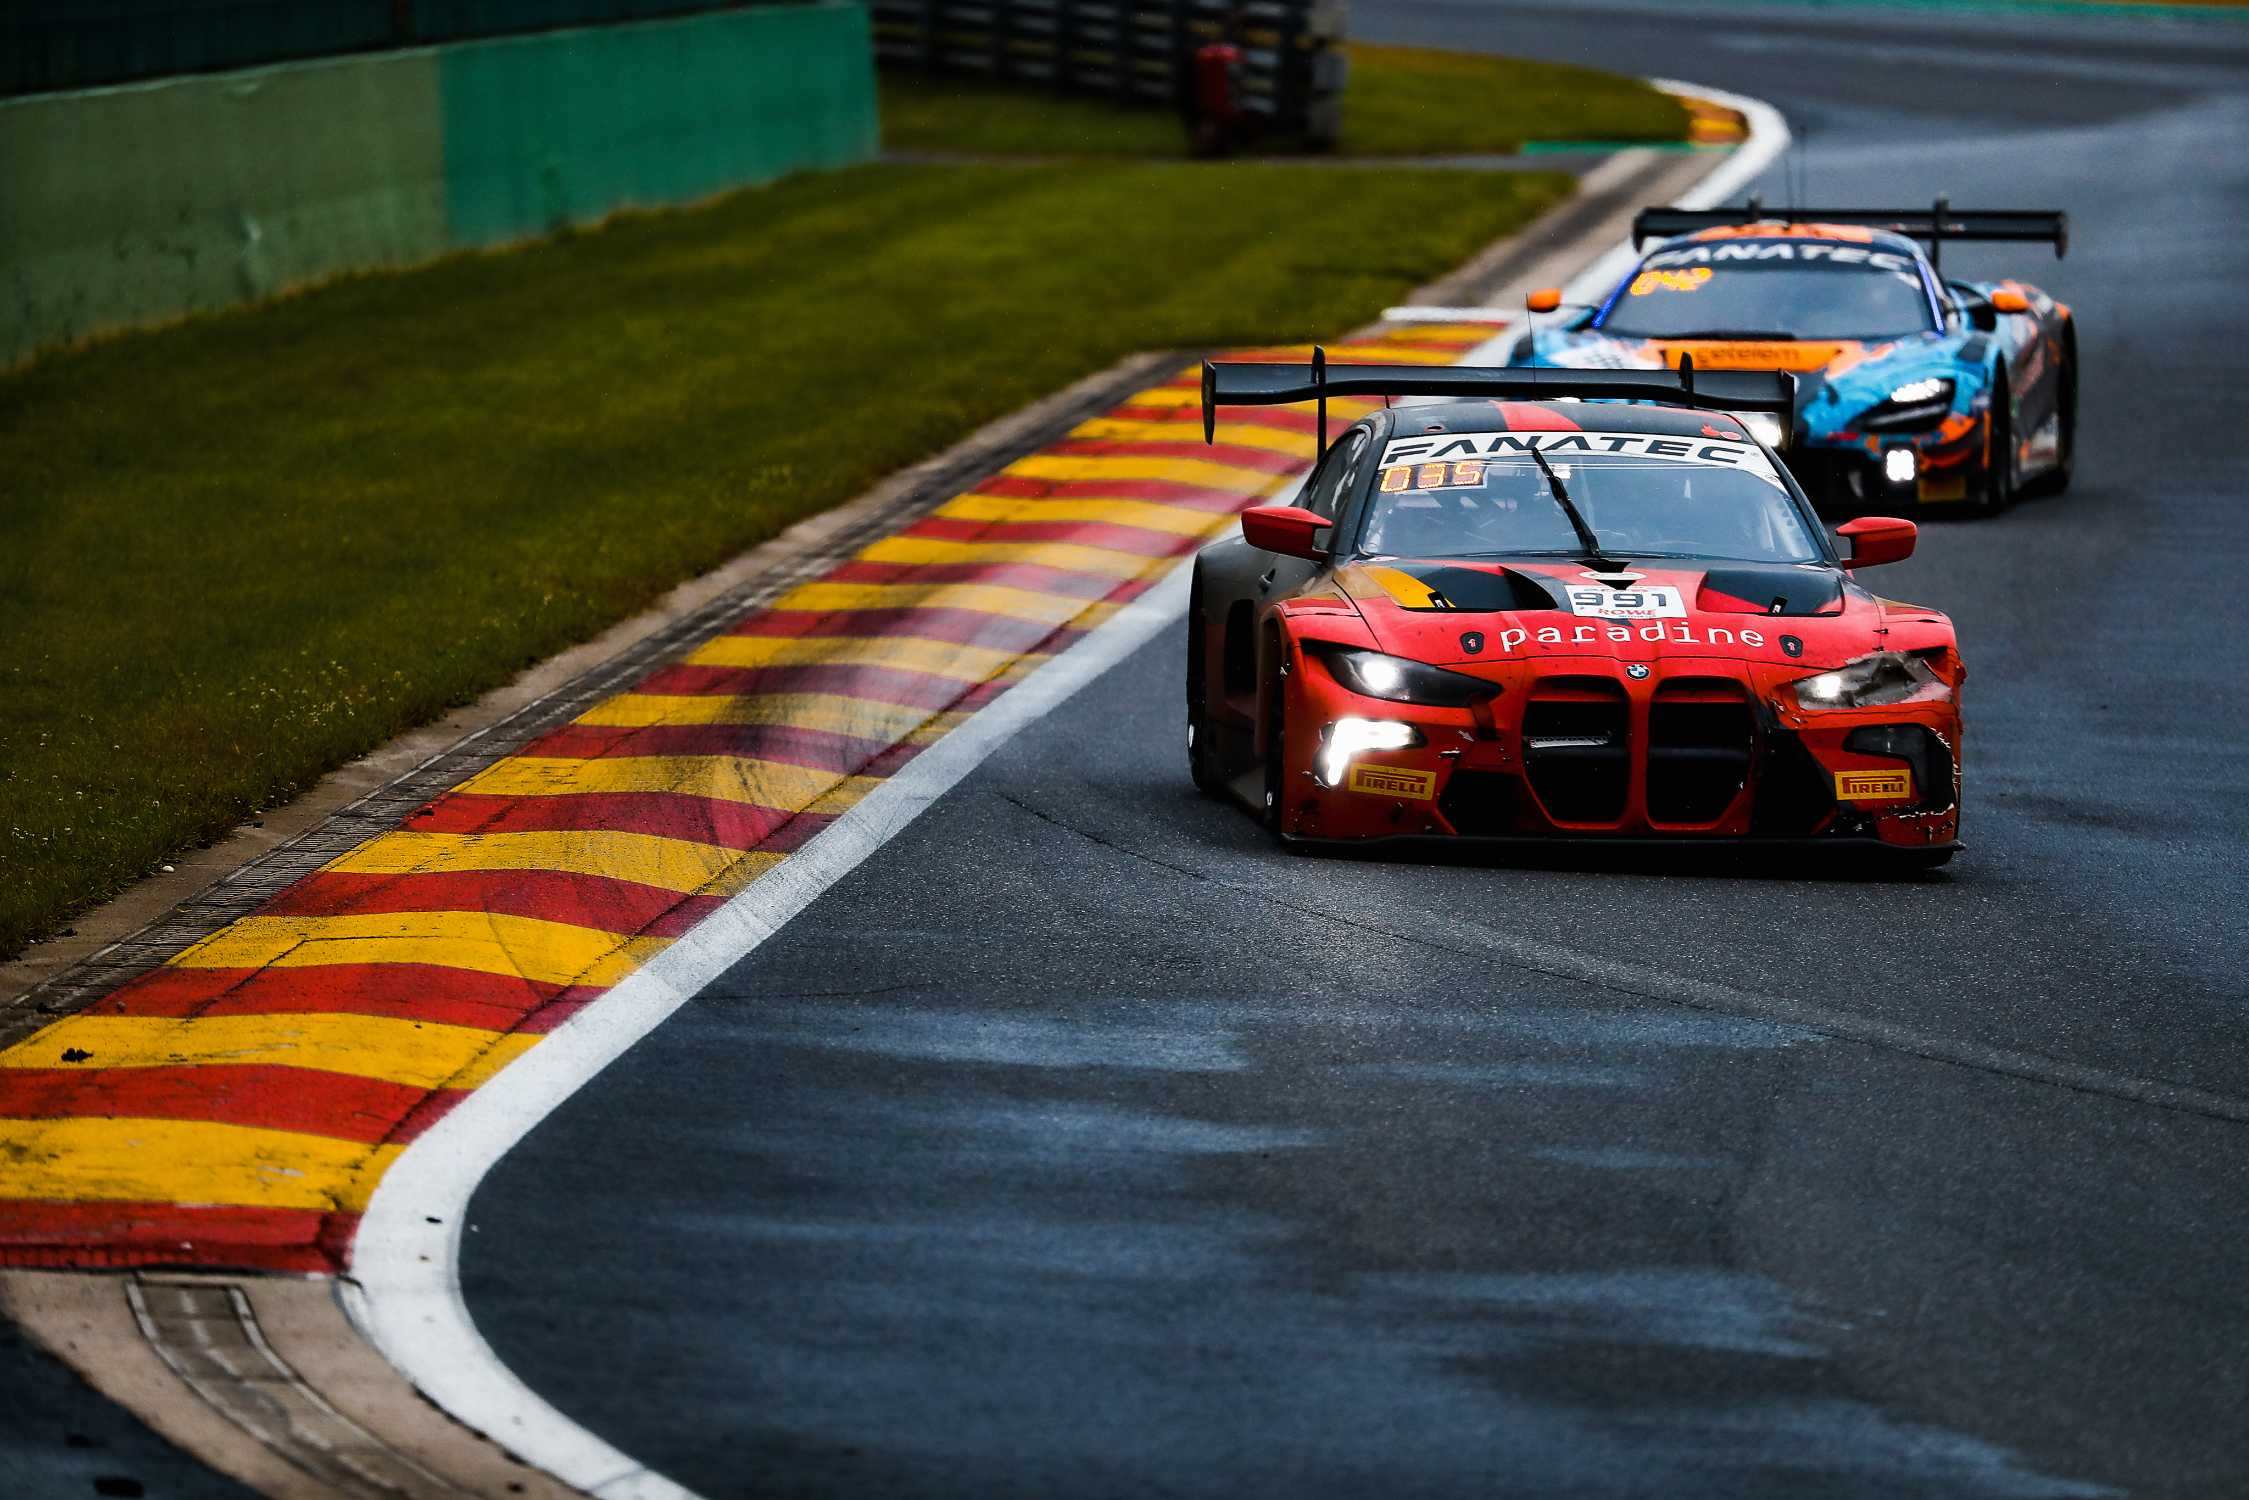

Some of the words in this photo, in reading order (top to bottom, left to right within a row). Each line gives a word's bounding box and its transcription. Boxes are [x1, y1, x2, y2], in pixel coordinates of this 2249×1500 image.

[1384, 435, 1745, 464] FANATEC
[1380, 461, 1482, 493] 035
[1574, 592, 1667, 608] 991
[1598, 608, 1656, 616] ROWE
[1500, 621, 1765, 652] paradine
[1356, 769, 1427, 794] PIRELLI
[1842, 776, 1905, 793] PIRELLI
